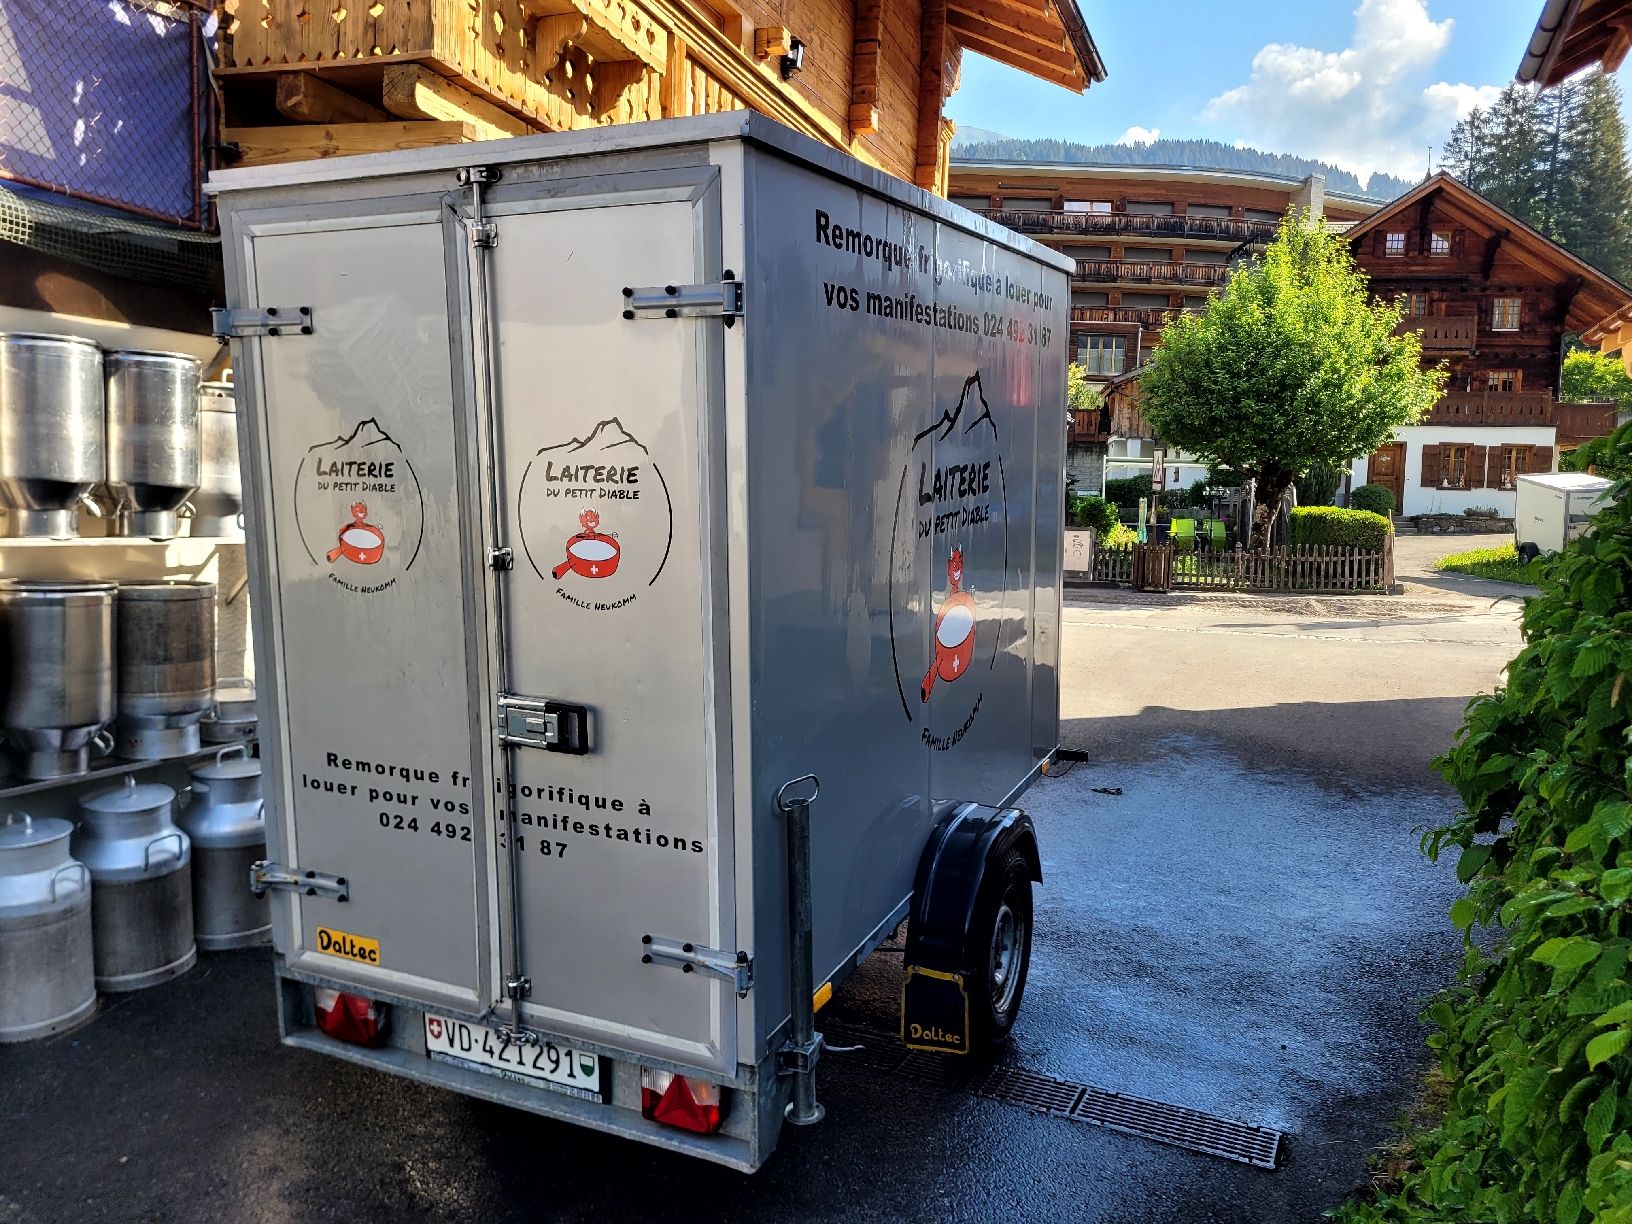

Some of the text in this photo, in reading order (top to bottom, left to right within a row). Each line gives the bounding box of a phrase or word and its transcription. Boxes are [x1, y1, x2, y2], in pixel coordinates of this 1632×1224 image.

[816, 208, 911, 272] Remorque
[995, 272, 1002, 296] à
[1005, 274, 1031, 304] louer
[1033, 290, 1052, 312] pour
[823, 282, 860, 311] vos
[866, 291, 979, 335] manifestations
[984, 311, 1003, 339] 024
[1028, 322, 1038, 346] 31
[1041, 326, 1052, 348] 87
[316, 457, 395, 479] LAITERIE
[545, 460, 639, 485] LAITERIE
[317, 481, 396, 493] DU PETIT DIABLE
[546, 487, 640, 500] DU PETIT DIABLE
[918, 460, 991, 507] LAITERIE
[918, 503, 990, 540] DU PETIT DIABLE
[328, 572, 397, 594] FAMILLE NEUKOMM
[555, 587, 637, 611] FAMILLE NEUKOMM
[921, 727, 951, 752] FAMILLE
[302, 773, 358, 796] louer
[368, 788, 419, 806] pour
[430, 798, 470, 815] vos
[326, 752, 440, 783] Remorque
[637, 798, 651, 817] à
[379, 812, 419, 832] 024
[430, 821, 472, 842] 492
[540, 839, 568, 859] 87
[318, 929, 377, 962] Daltec
[910, 1023, 961, 1044] Daltec
